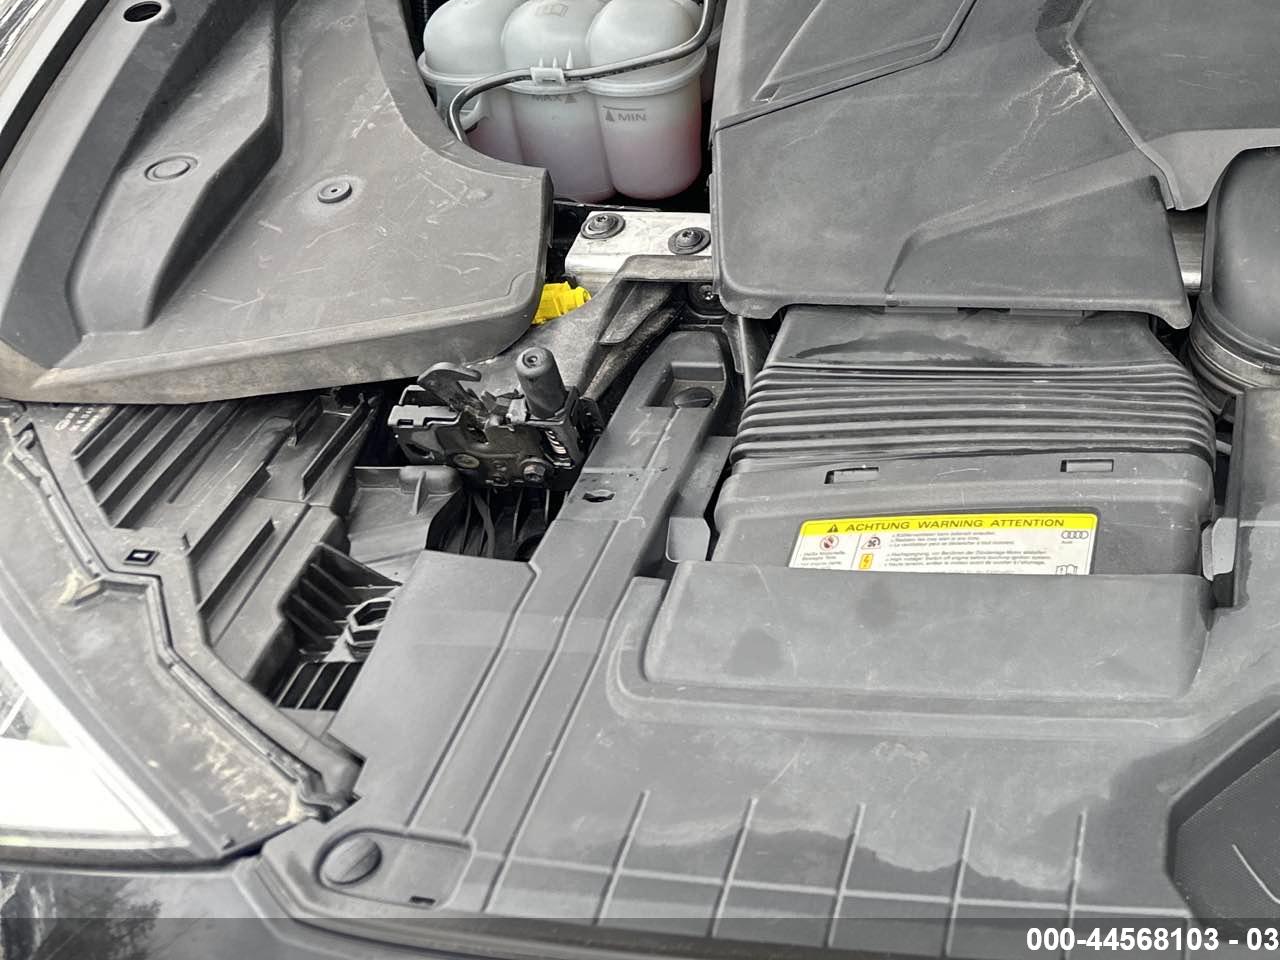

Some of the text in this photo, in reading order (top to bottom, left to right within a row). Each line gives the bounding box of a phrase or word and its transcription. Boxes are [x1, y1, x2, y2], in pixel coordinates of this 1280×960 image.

[618, 112, 647, 121] MIN
[845, 518, 1065, 532] ACHTUNG WARNING ATTENTION
